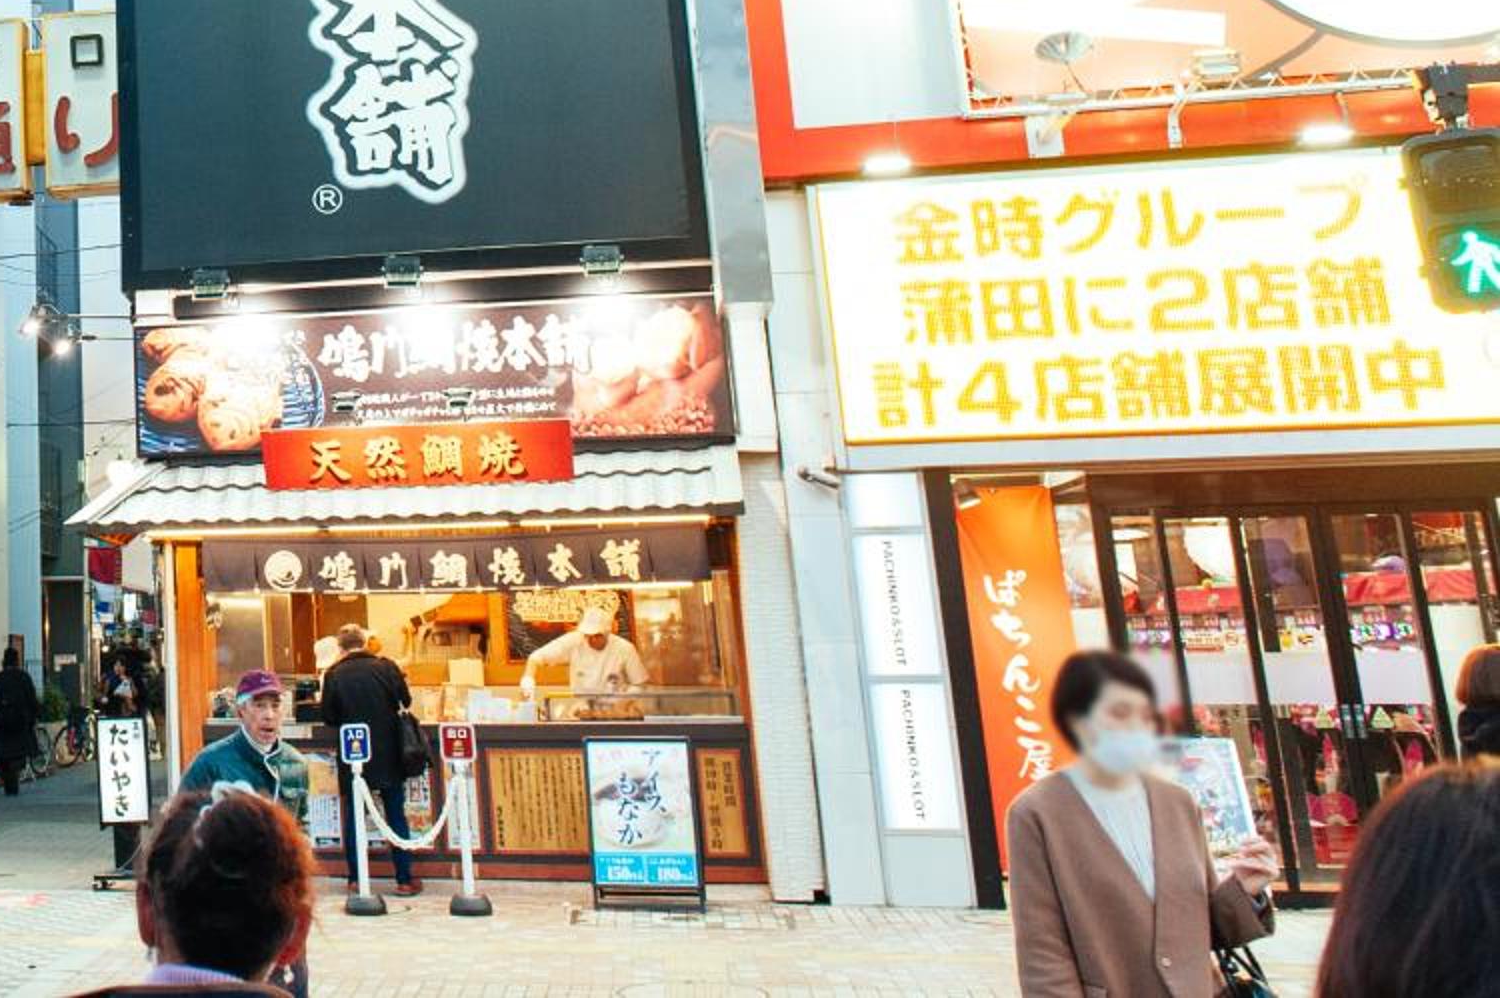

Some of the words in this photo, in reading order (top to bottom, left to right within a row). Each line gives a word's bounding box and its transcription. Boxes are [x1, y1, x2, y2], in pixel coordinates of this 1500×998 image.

[893, 172, 1368, 267] 金時グループ
[899, 257, 1393, 347] 蒲田に2店舗
[872, 339, 1447, 429] 計4店舗展開中
[309, 430, 527, 482] 天然鯛焼
[318, 538, 641, 591] 鳴門鯛焼本舗
[109, 722, 132, 817] たいやき
[617, 771, 643, 846] もなか
